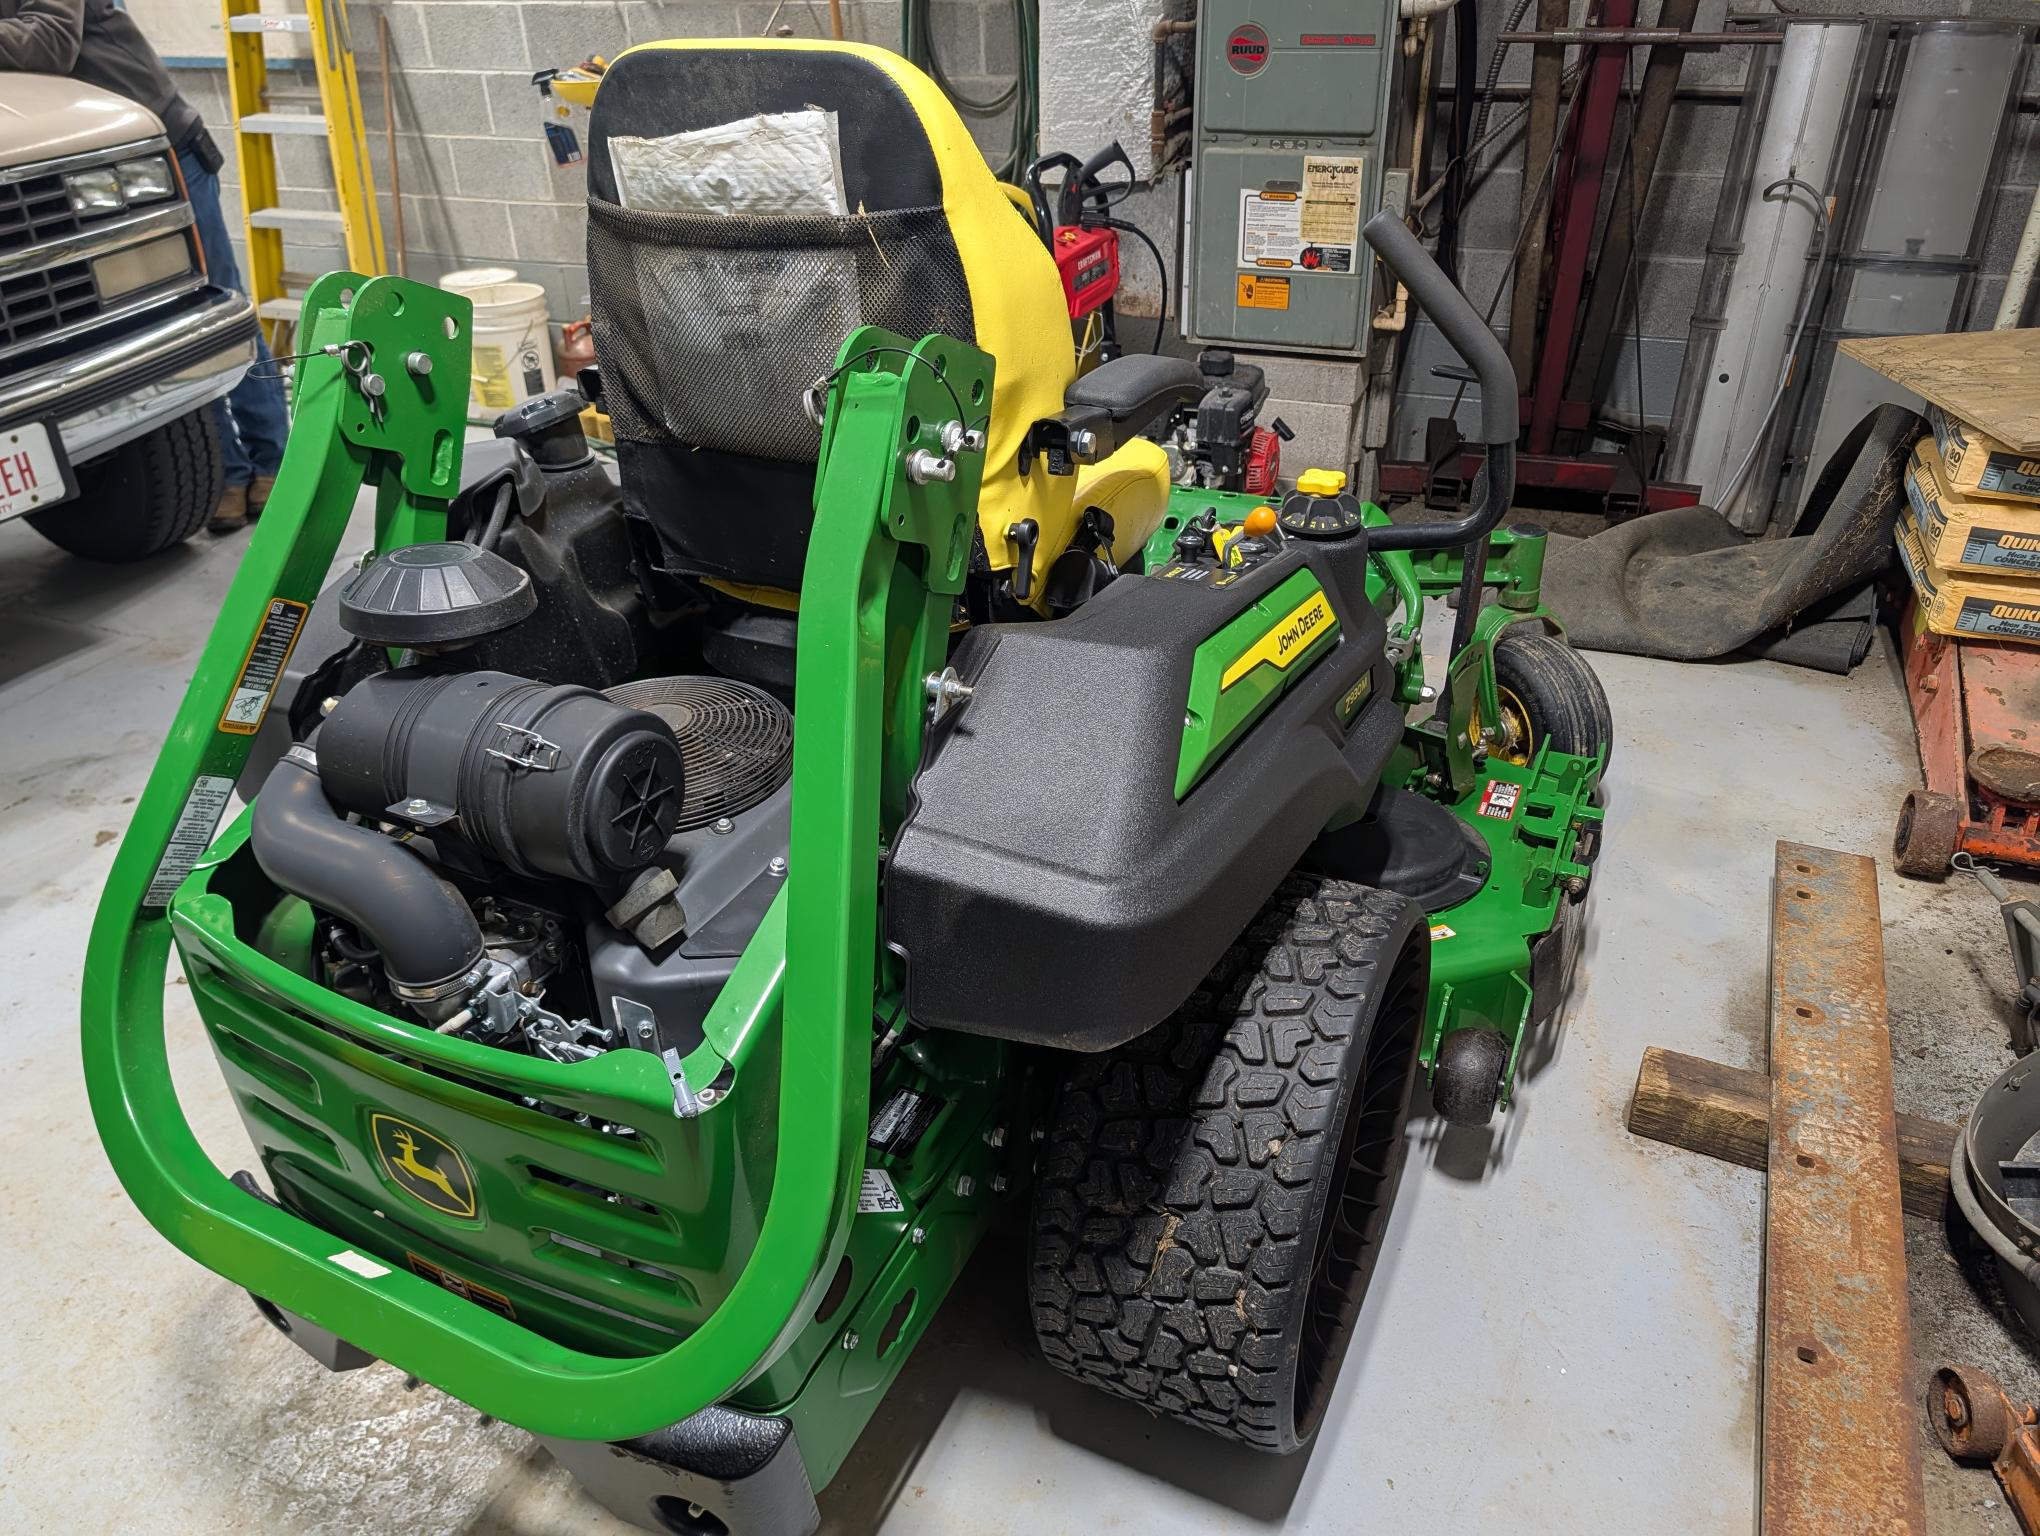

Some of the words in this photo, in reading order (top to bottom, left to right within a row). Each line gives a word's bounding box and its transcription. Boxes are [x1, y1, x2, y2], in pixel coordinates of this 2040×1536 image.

[1232, 45, 1264, 55] RUUD
[1307, 164, 1359, 175] ENERGYGUIDE
[1078, 250, 1101, 270] CRAFTSMAN
[1950, 448, 1961, 464] 80
[1915, 462, 1942, 503] QUIKRETE
[1930, 522, 1942, 540] 80
[1920, 591, 1932, 608] 80
[1278, 625, 1300, 656] JOHN
[1297, 603, 1324, 636] DEERE
[1313, 1141, 1337, 1203] TWEEL
